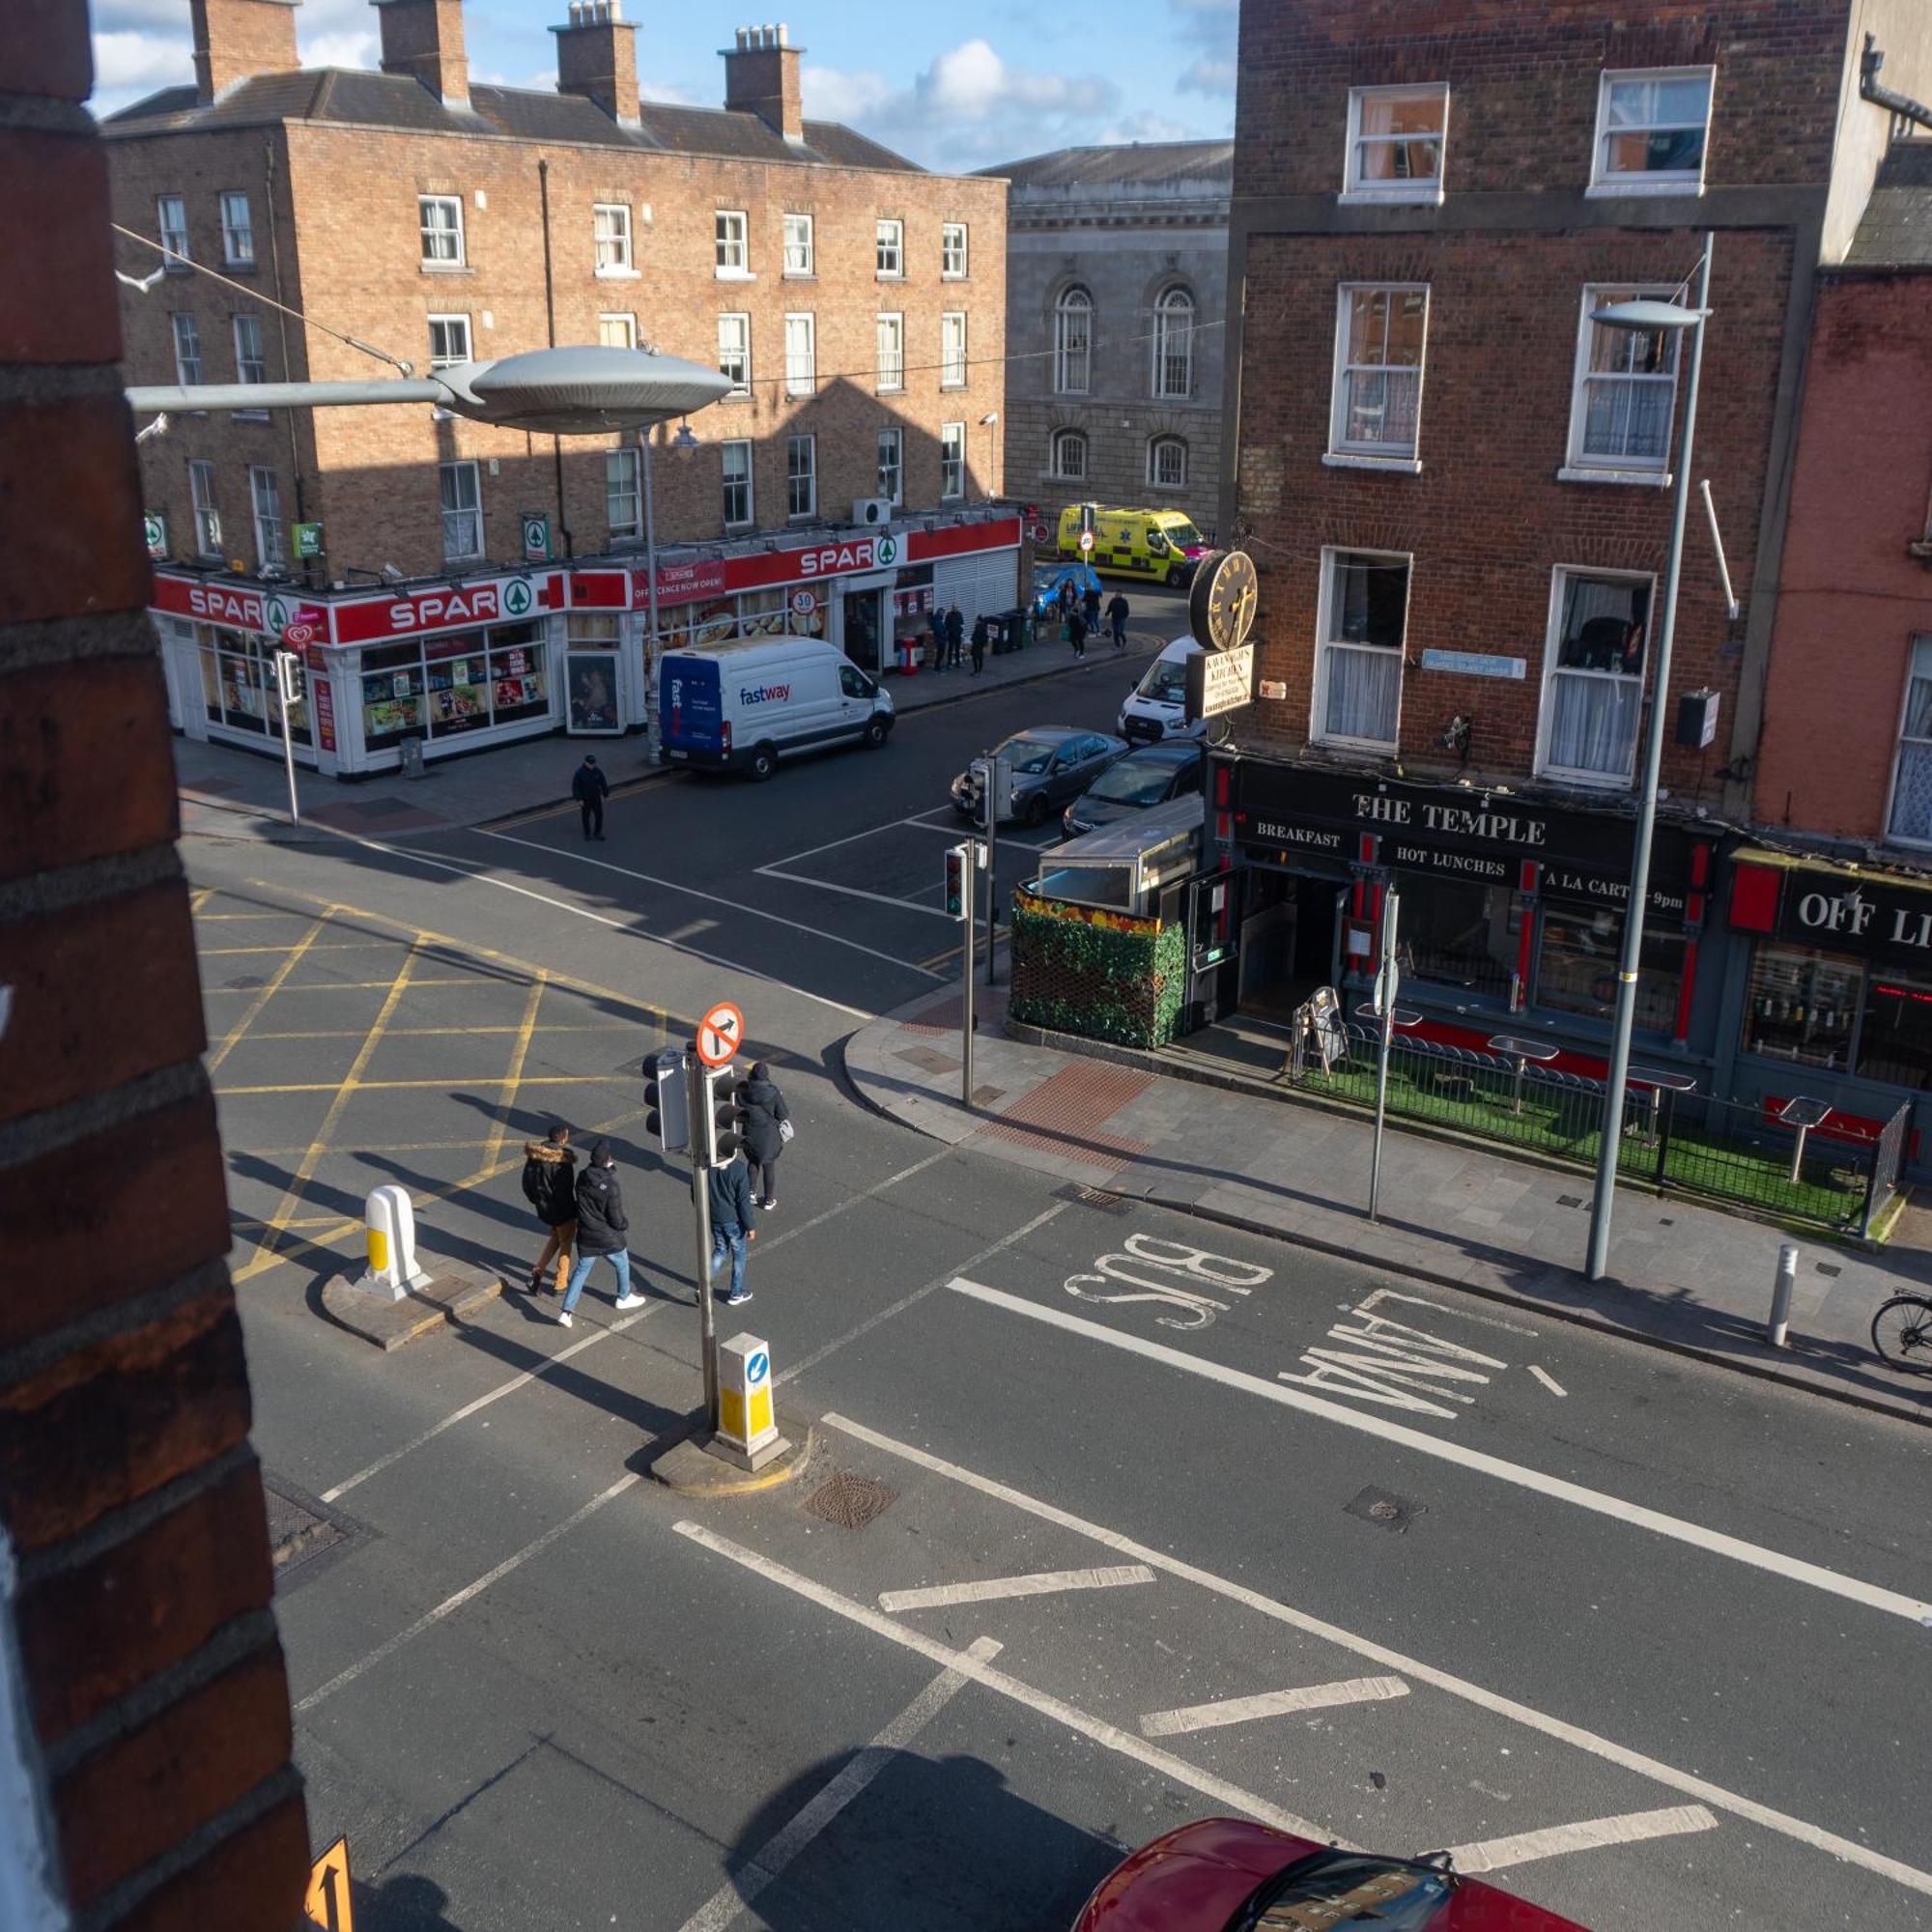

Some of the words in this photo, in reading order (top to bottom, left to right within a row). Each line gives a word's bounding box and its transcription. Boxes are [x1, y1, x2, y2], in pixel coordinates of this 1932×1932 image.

[800, 544, 872, 575] SPAR
[188, 588, 263, 626] SPAR
[634, 588, 649, 599] OFF
[680, 581, 699, 591] NOW
[389, 590, 497, 630] SPAR
[740, 683, 790, 706] fastway
[1257, 821, 1341, 848] BREAKFAST
[1352, 793, 1411, 825] THE
[1422, 804, 1546, 846] TEMPLE
[1397, 846, 1428, 865] HOT
[1434, 851, 1506, 877] LUNCHES
[1546, 872, 1556, 886] A
[1561, 873, 1585, 891] LA
[1587, 878, 1631, 898] CART
[1653, 891, 1684, 909] 9pm
[1799, 892, 1877, 936] OFF
[1063, 1232, 1275, 1331] BUS
